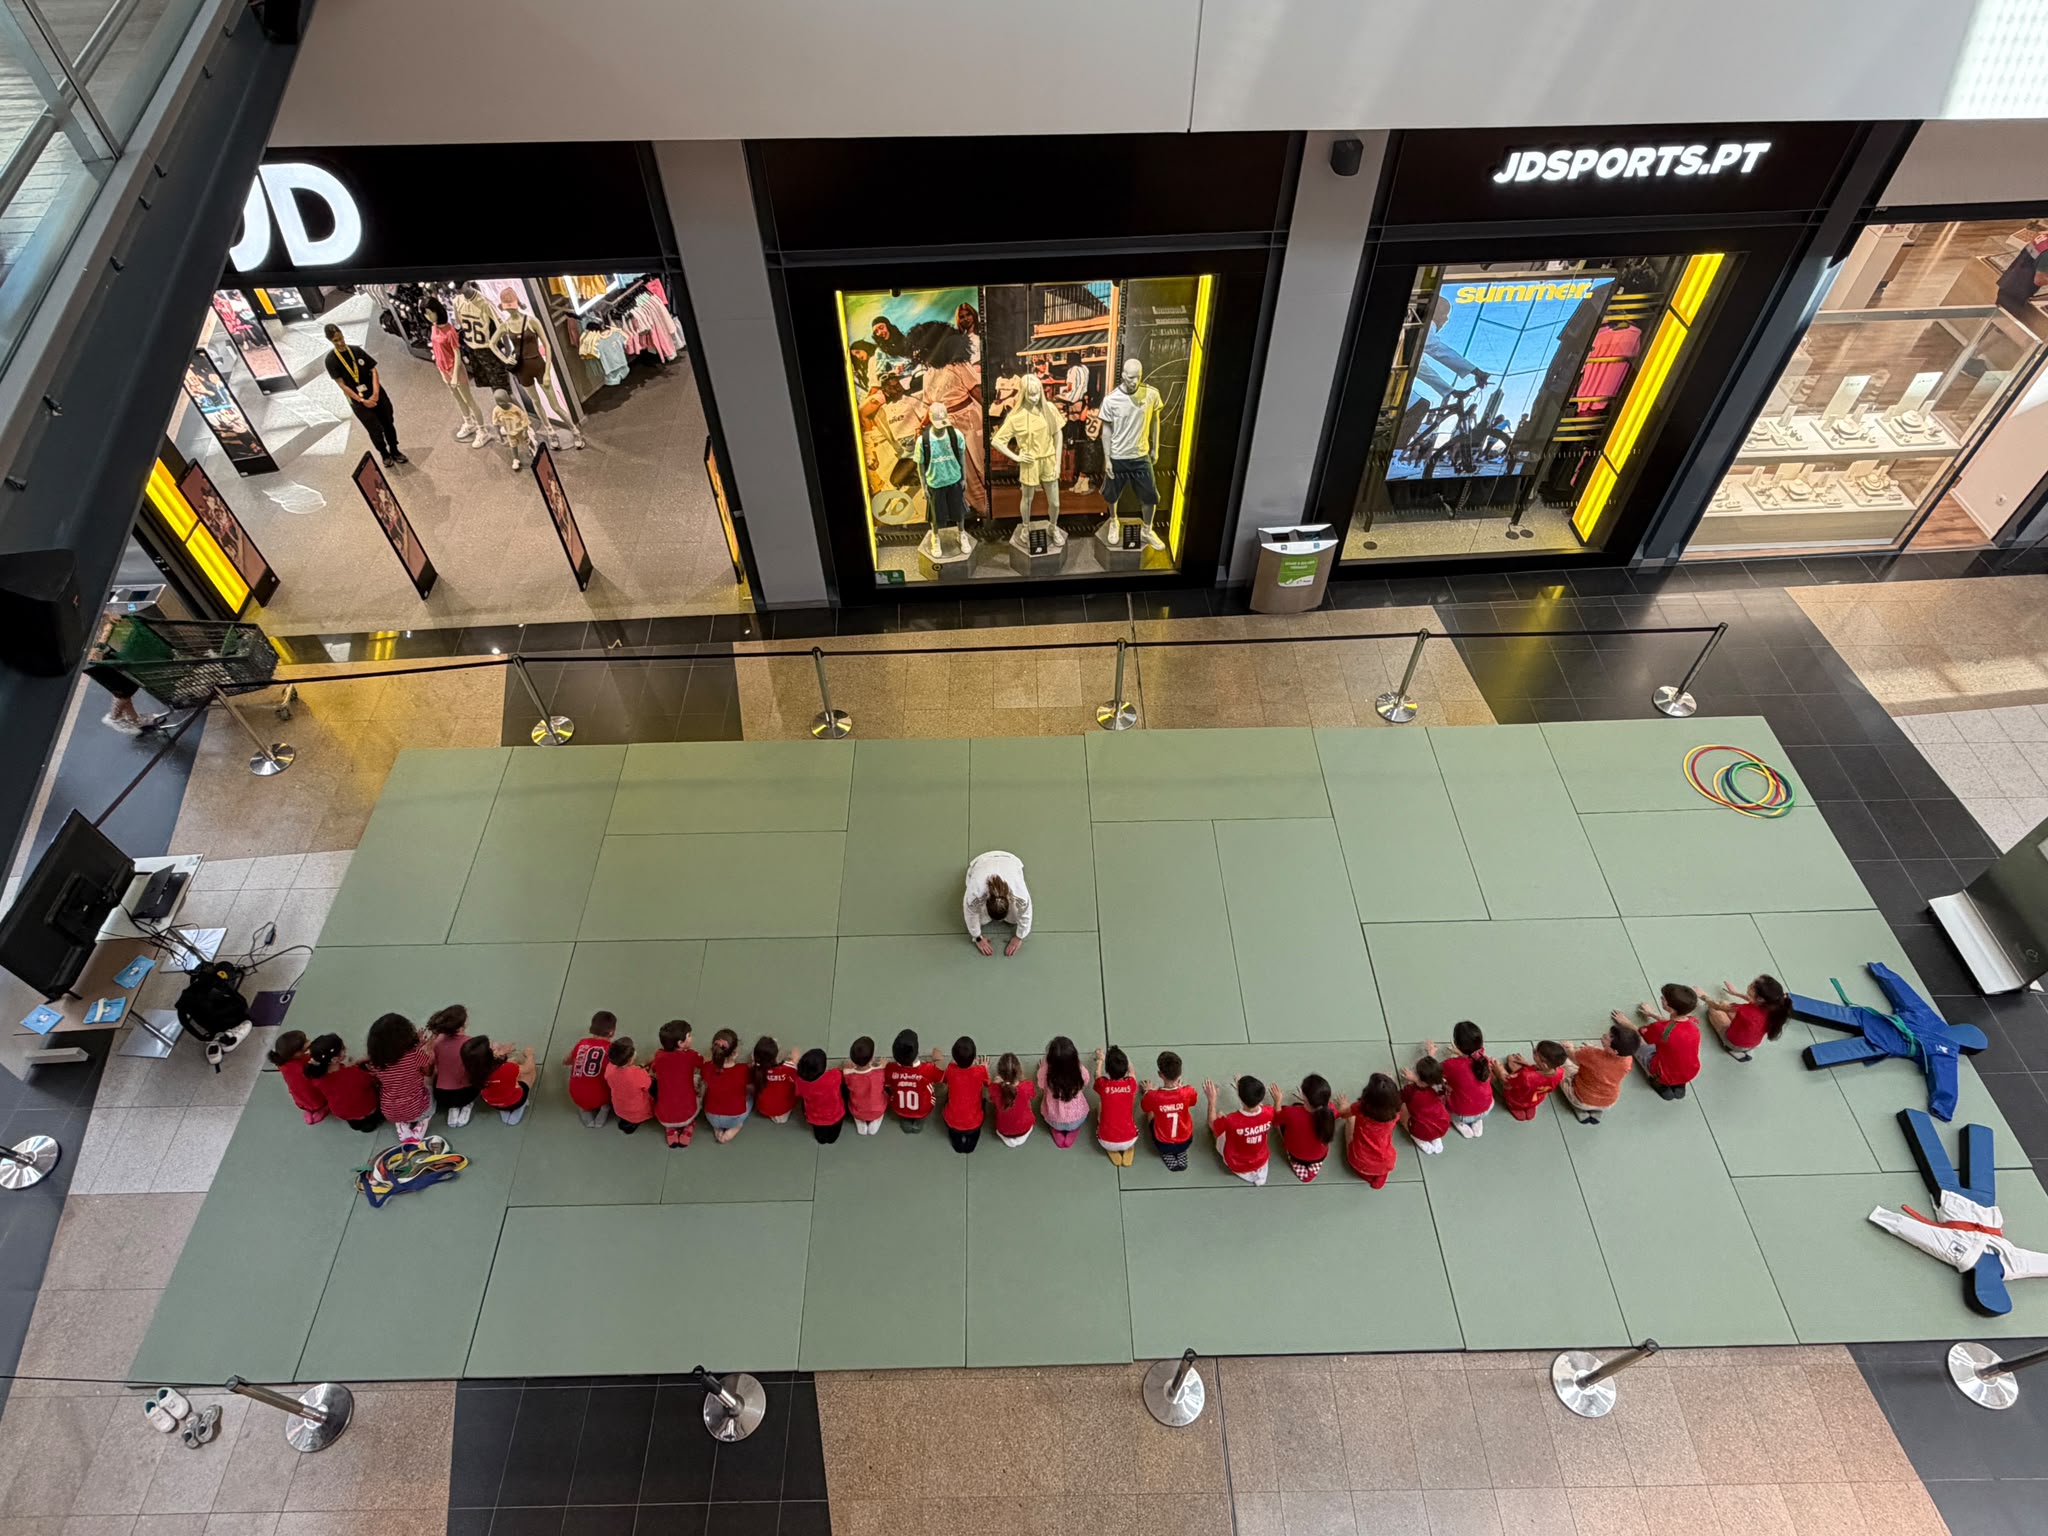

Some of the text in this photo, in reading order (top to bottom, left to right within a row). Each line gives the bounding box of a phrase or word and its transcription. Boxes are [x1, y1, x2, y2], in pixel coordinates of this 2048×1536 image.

[1493, 143, 1771, 183] JDSPORTS.PT
[229, 163, 362, 272] JD
[1456, 282, 1593, 304] summer.
[878, 498, 908, 517] JD
[583, 1046, 605, 1077] 8
[897, 1090, 919, 1111] 10
[1167, 1112, 1179, 1138] 7
[1244, 1121, 1272, 1136] SAGRES
